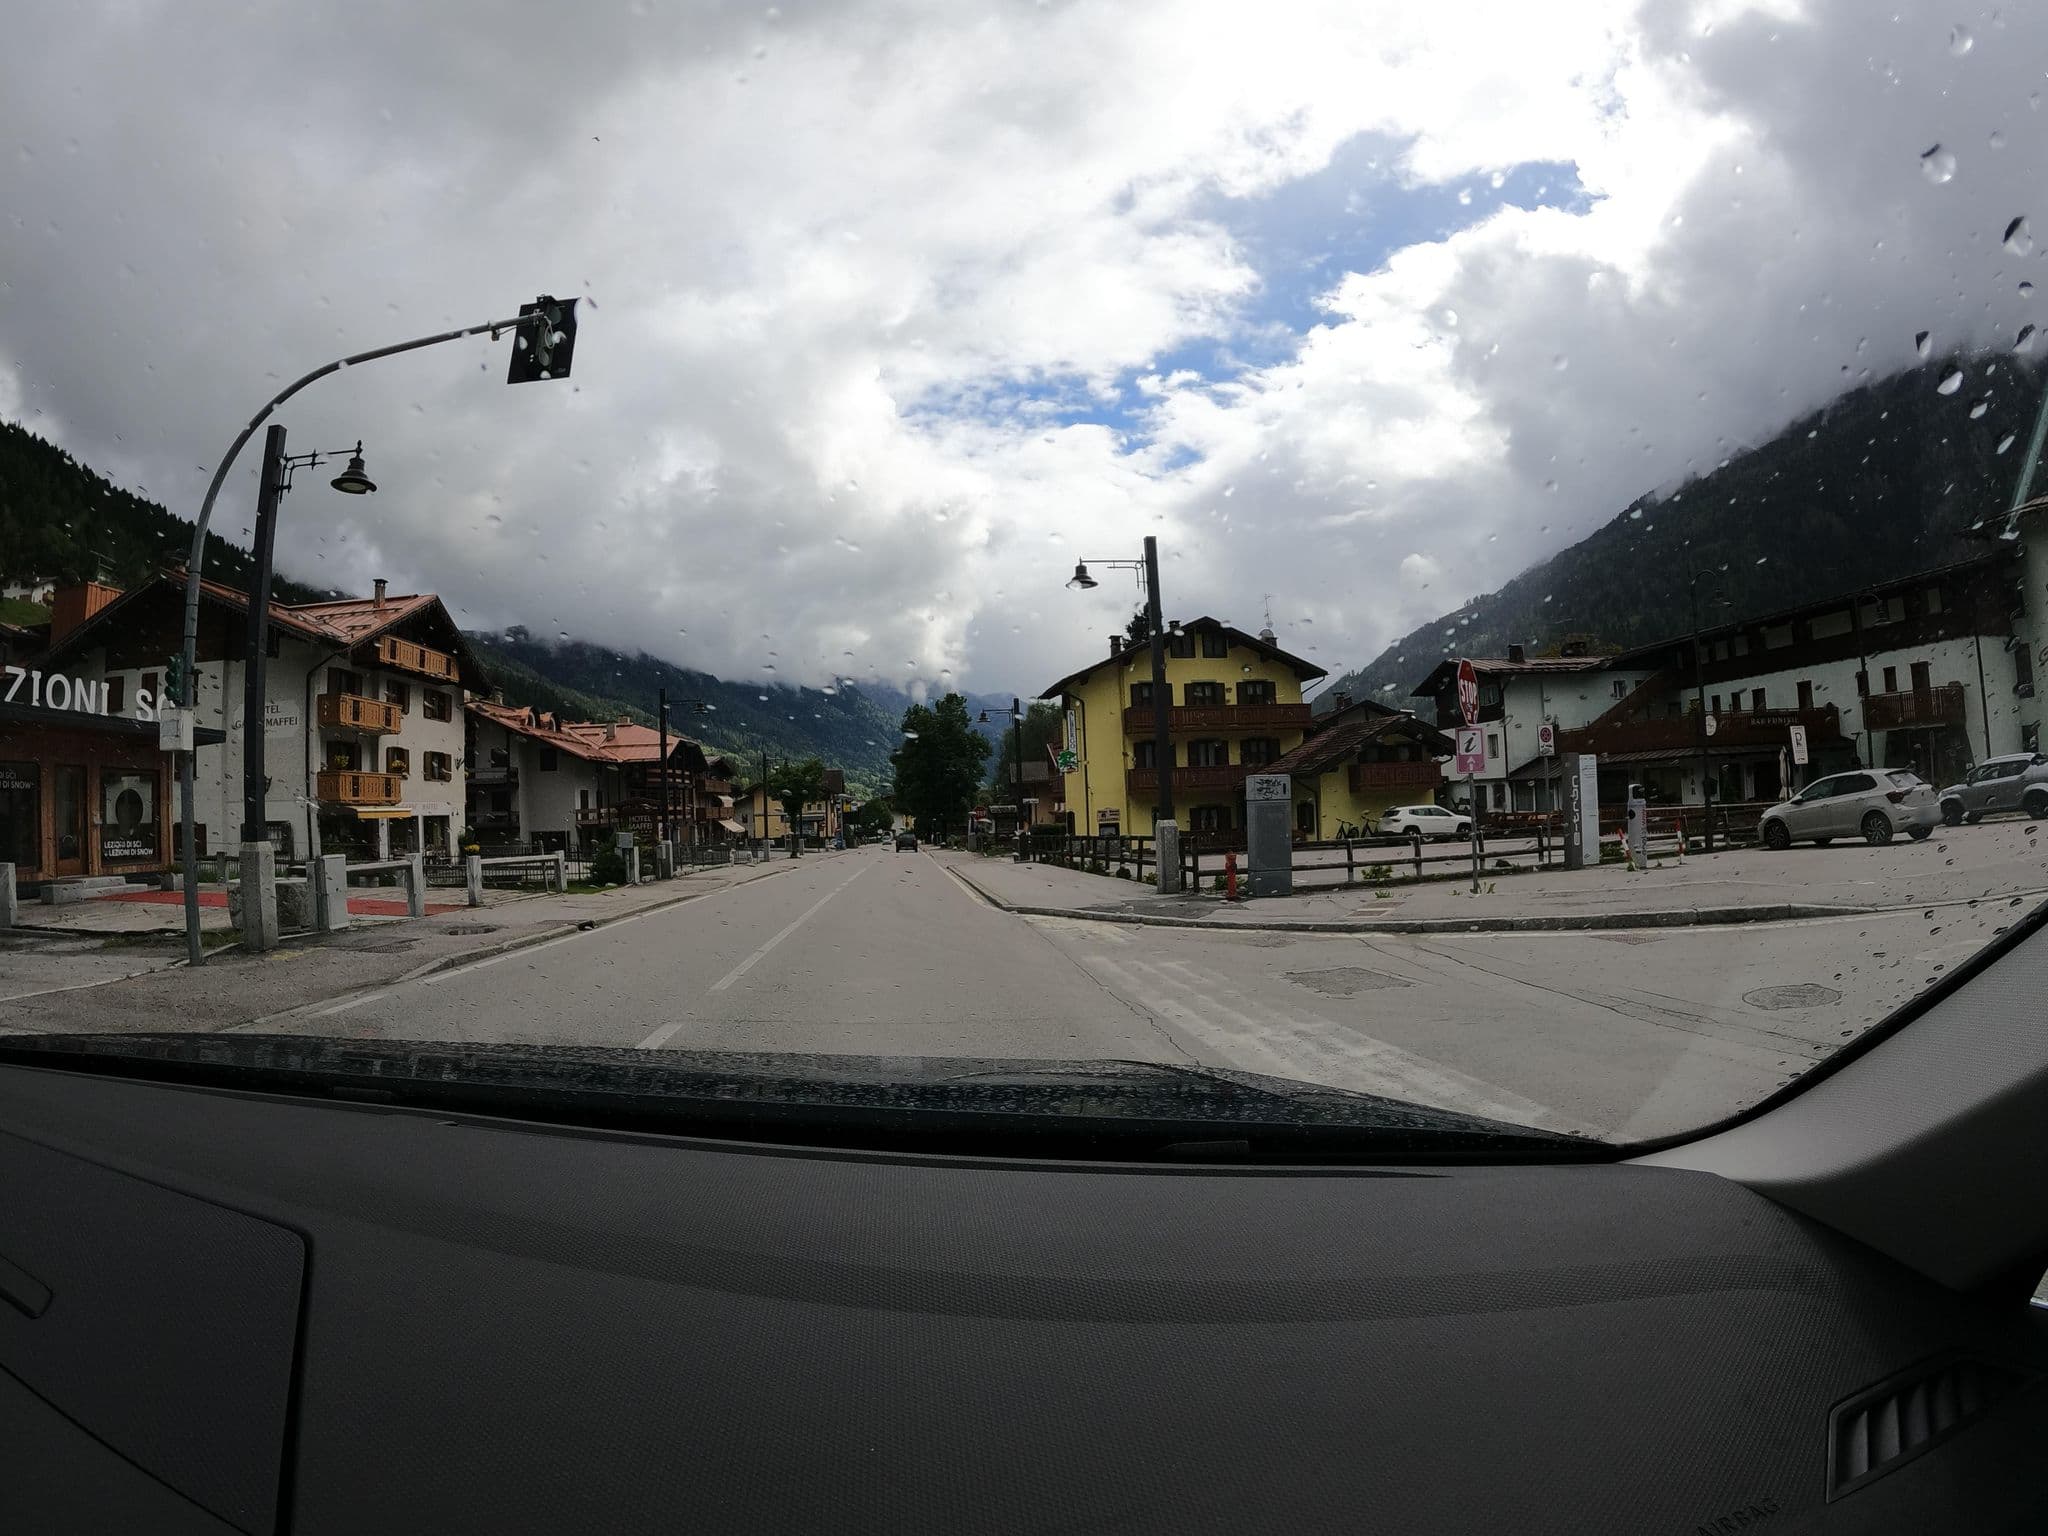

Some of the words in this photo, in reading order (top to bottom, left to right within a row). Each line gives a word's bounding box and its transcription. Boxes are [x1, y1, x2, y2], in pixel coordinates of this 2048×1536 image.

[1460, 679, 1478, 705] STOP
[265, 717, 298, 727] MAFFEI
[104, 840, 126, 849] LEZIONI
[126, 840, 133, 848] DI
[133, 840, 142, 848] SCI
[108, 848, 131, 857] LEZIONI
[131, 848, 137, 856] DI
[137, 848, 154, 856] SNOW
[1696, 1497, 1780, 1536] AIRBAG
